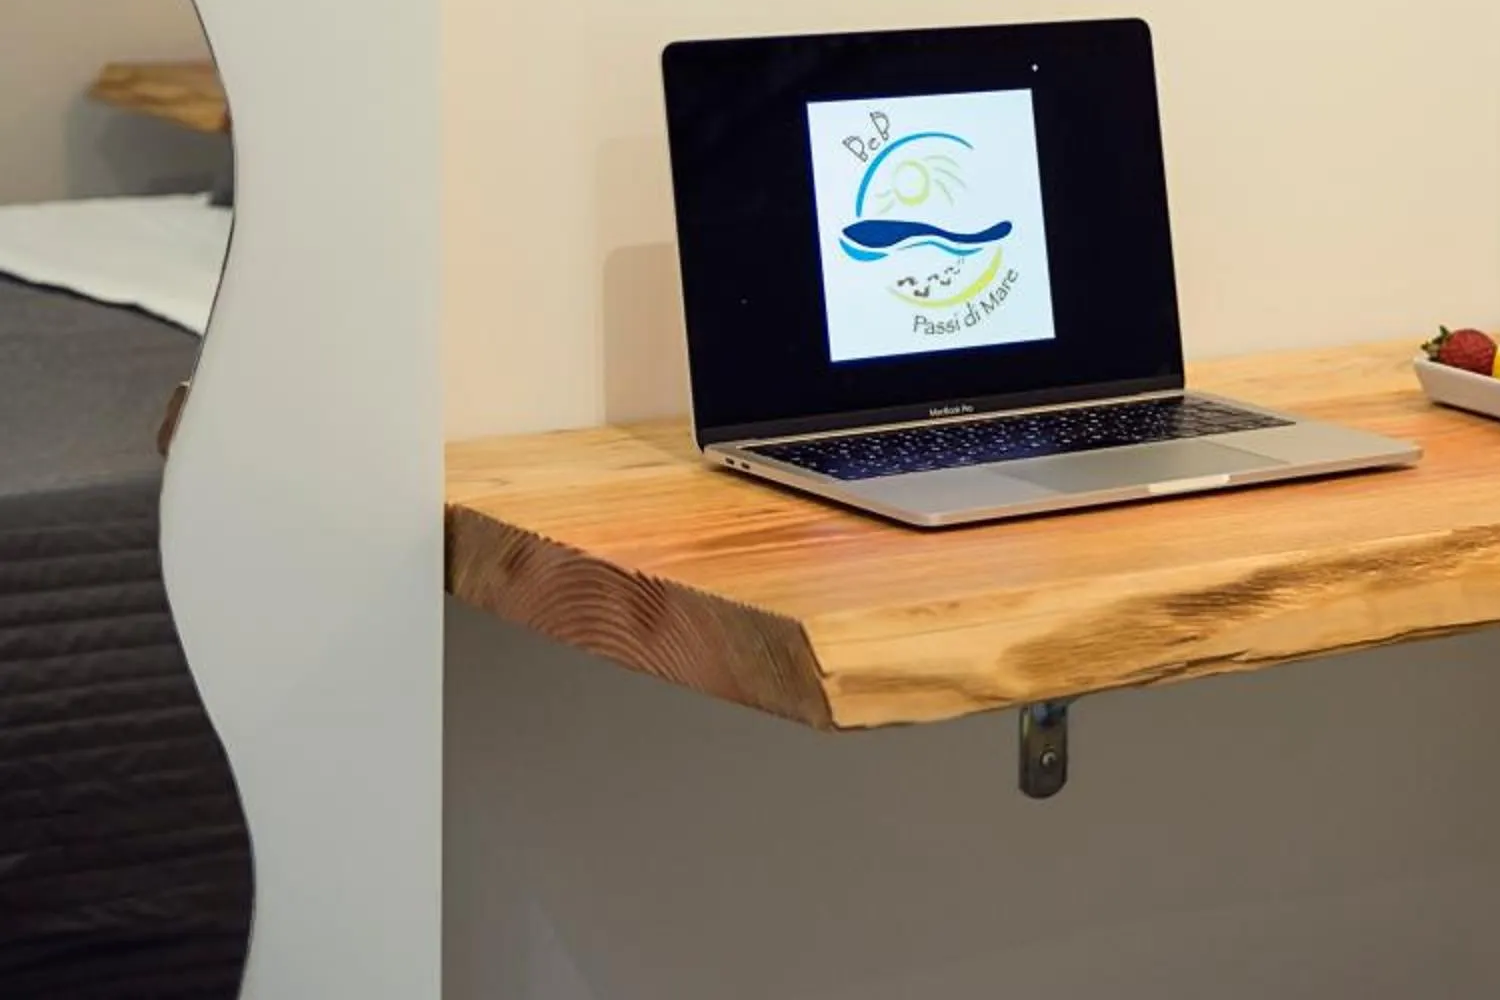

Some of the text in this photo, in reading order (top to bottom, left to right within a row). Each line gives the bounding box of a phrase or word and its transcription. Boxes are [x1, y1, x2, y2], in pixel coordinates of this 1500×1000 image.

[913, 268, 1019, 335] Passi di Mare
